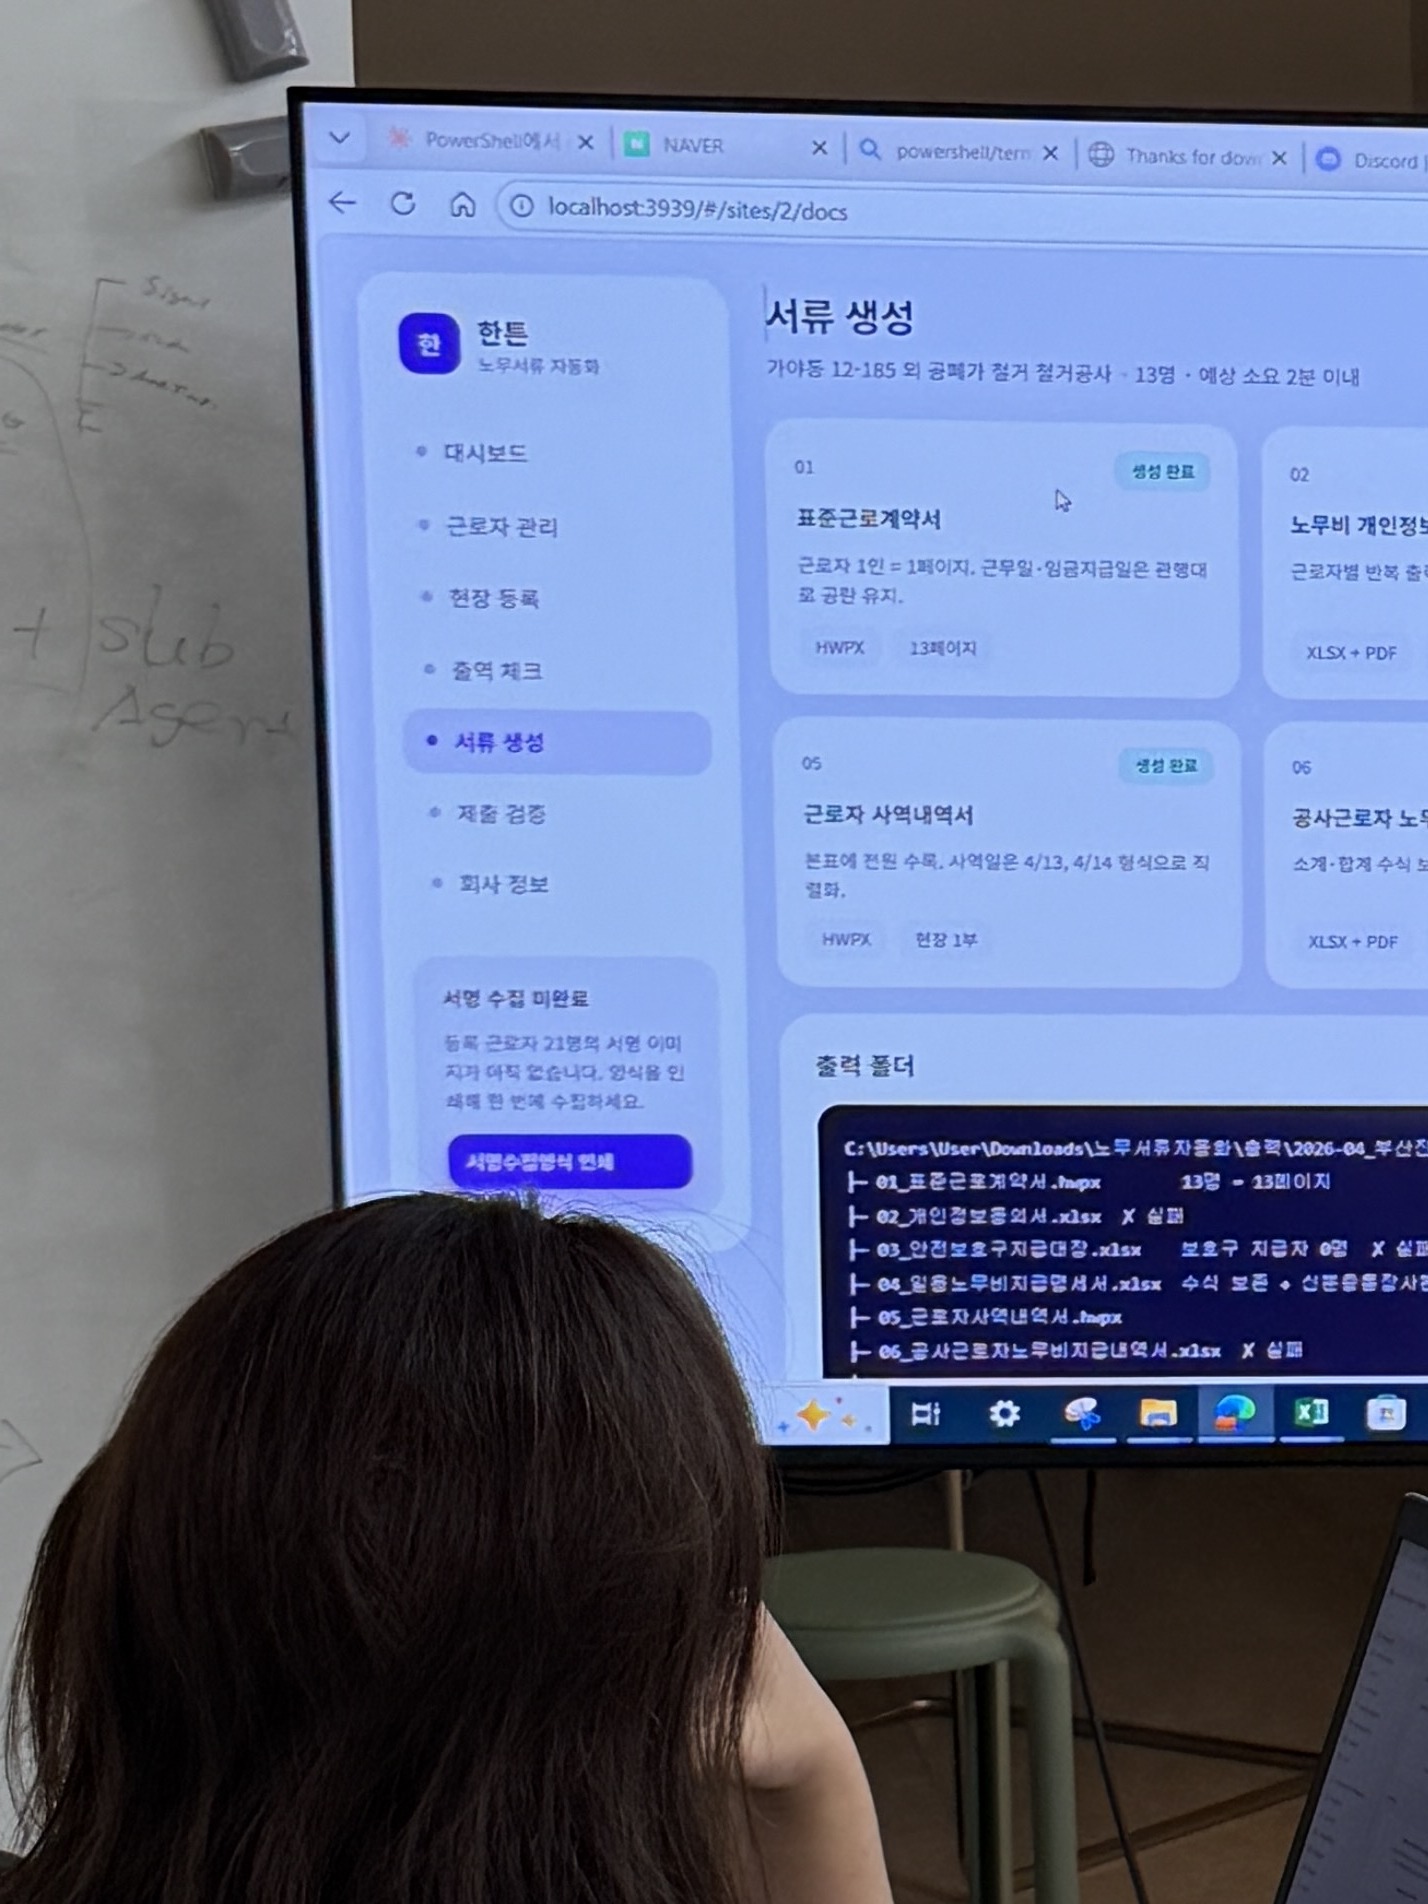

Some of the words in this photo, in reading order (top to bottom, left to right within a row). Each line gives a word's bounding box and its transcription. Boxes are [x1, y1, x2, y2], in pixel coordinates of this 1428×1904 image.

[664, 136, 724, 154] NAVER
[1126, 146, 1187, 167] Thanks
[1193, 147, 1216, 167] for
[1355, 152, 1418, 171] Discord
[548, 196, 848, 222] localhost:3939/#/sites/2/docs
[767, 297, 834, 337] 서류
[846, 298, 914, 338] 생성
[417, 334, 442, 355] 한
[476, 320, 528, 348] 한튼
[768, 358, 824, 378] 가야동
[832, 360, 896, 380] 12-185
[902, 362, 920, 380] 외
[1136, 366, 1174, 384] 13명
[1198, 366, 1236, 386] 예상
[1242, 368, 1280, 384] 소요
[1286, 368, 1316, 388] 2분
[1322, 368, 1360, 388] 이내
[444, 442, 528, 464] 대시보드
[794, 460, 814, 474] 01
[1290, 466, 1310, 482] 02
[446, 516, 510, 538] 근로자
[516, 518, 558, 538] 관리
[796, 508, 940, 530] 표준근로계약서
[1290, 514, 1350, 536] 노무비
[798, 556, 850, 574] 근로자
[1290, 562, 1360, 582] 근로자별
[448, 588, 492, 610] 현장
[498, 588, 540, 610] 등록
[816, 640, 866, 654] HWPX
[1306, 646, 1346, 660] XLSX
[1366, 646, 1398, 660] PDF
[454, 732, 498, 754] 서류
[502, 732, 544, 754] 생성
[800, 756, 822, 770] 05
[1292, 760, 1312, 776] 06
[804, 804, 866, 824] 근로자
[872, 804, 974, 826] 사역내역서
[1292, 808, 1392, 830] 공사근로자
[1024, 854, 1068, 872] 4/13,
[1072, 854, 1112, 872] 4/14
[460, 874, 502, 894] 회사
[508, 874, 550, 896] 정보
[822, 932, 872, 946] HWPX
[1308, 934, 1348, 950] XLSX
[1366, 934, 1398, 950] PDF
